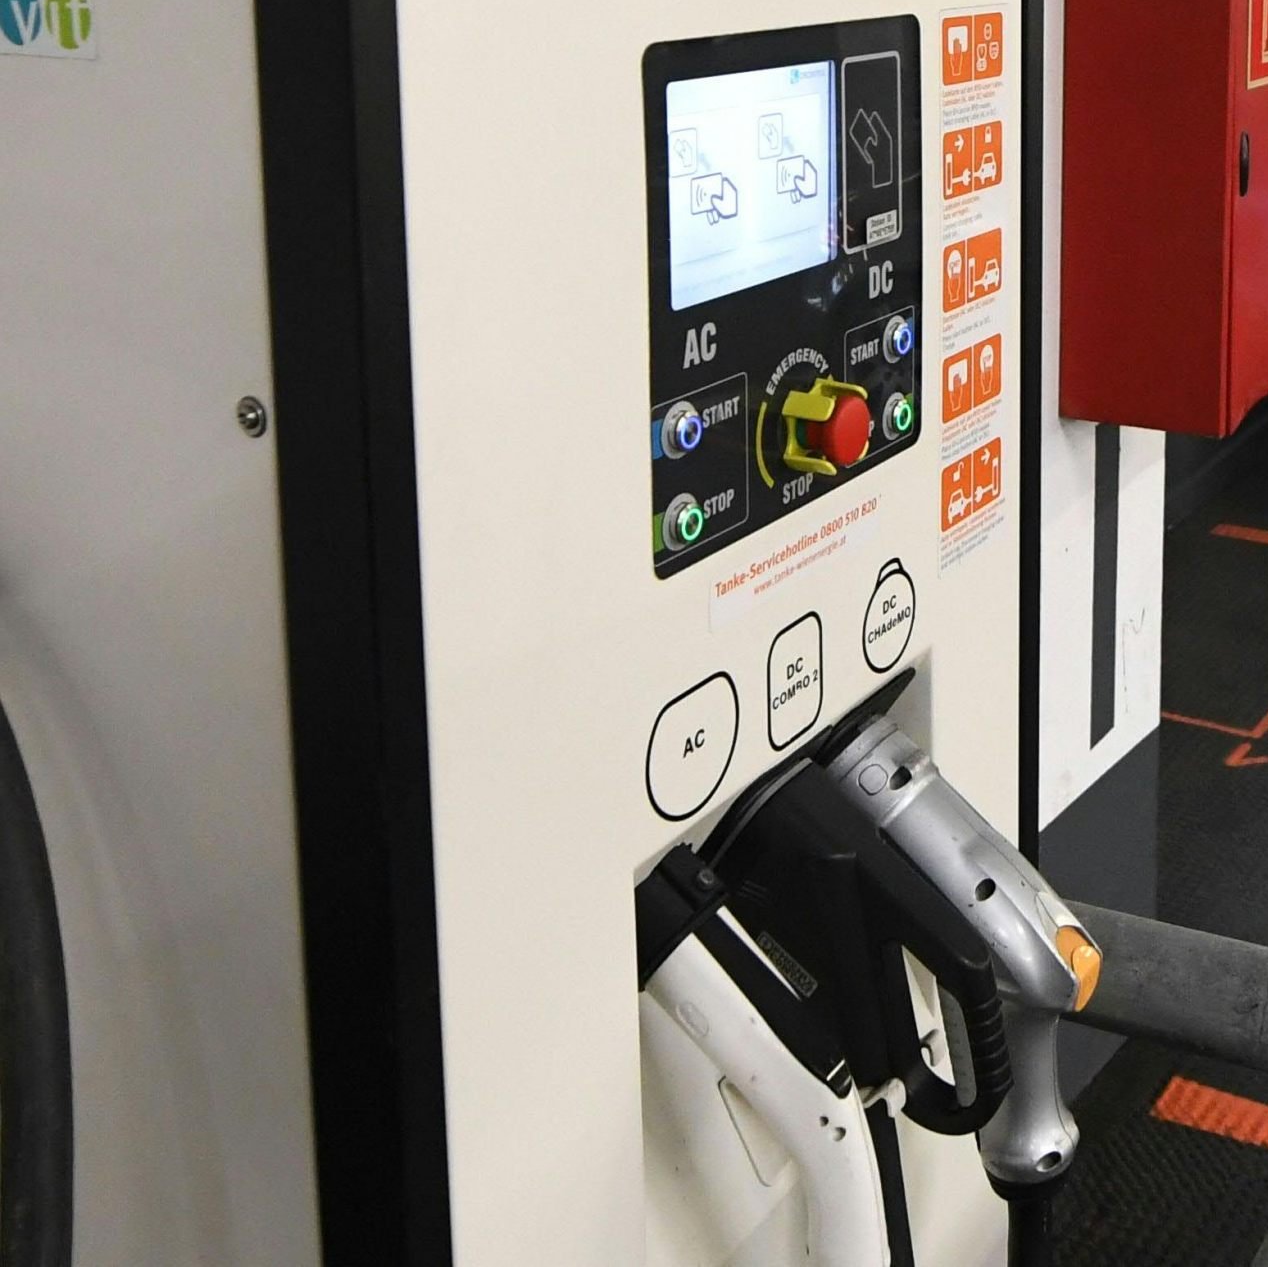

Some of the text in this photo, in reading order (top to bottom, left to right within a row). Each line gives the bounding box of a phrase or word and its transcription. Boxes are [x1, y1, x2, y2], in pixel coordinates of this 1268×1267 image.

[868, 260, 894, 299] DC
[682, 322, 717, 369] AC
[850, 339, 879, 365] START
[766, 347, 829, 396] EMERGENCY
[702, 396, 740, 428] START
[703, 489, 735, 519] STOP
[783, 472, 814, 505] STOP
[715, 497, 878, 598] Tanke-Servicehotline 0800 510 820
[883, 594, 897, 615] DC
[867, 605, 911, 644] CHAdeMO
[787, 657, 803, 680] DC
[812, 669, 818, 682] 2
[682, 729, 705, 758] AC
